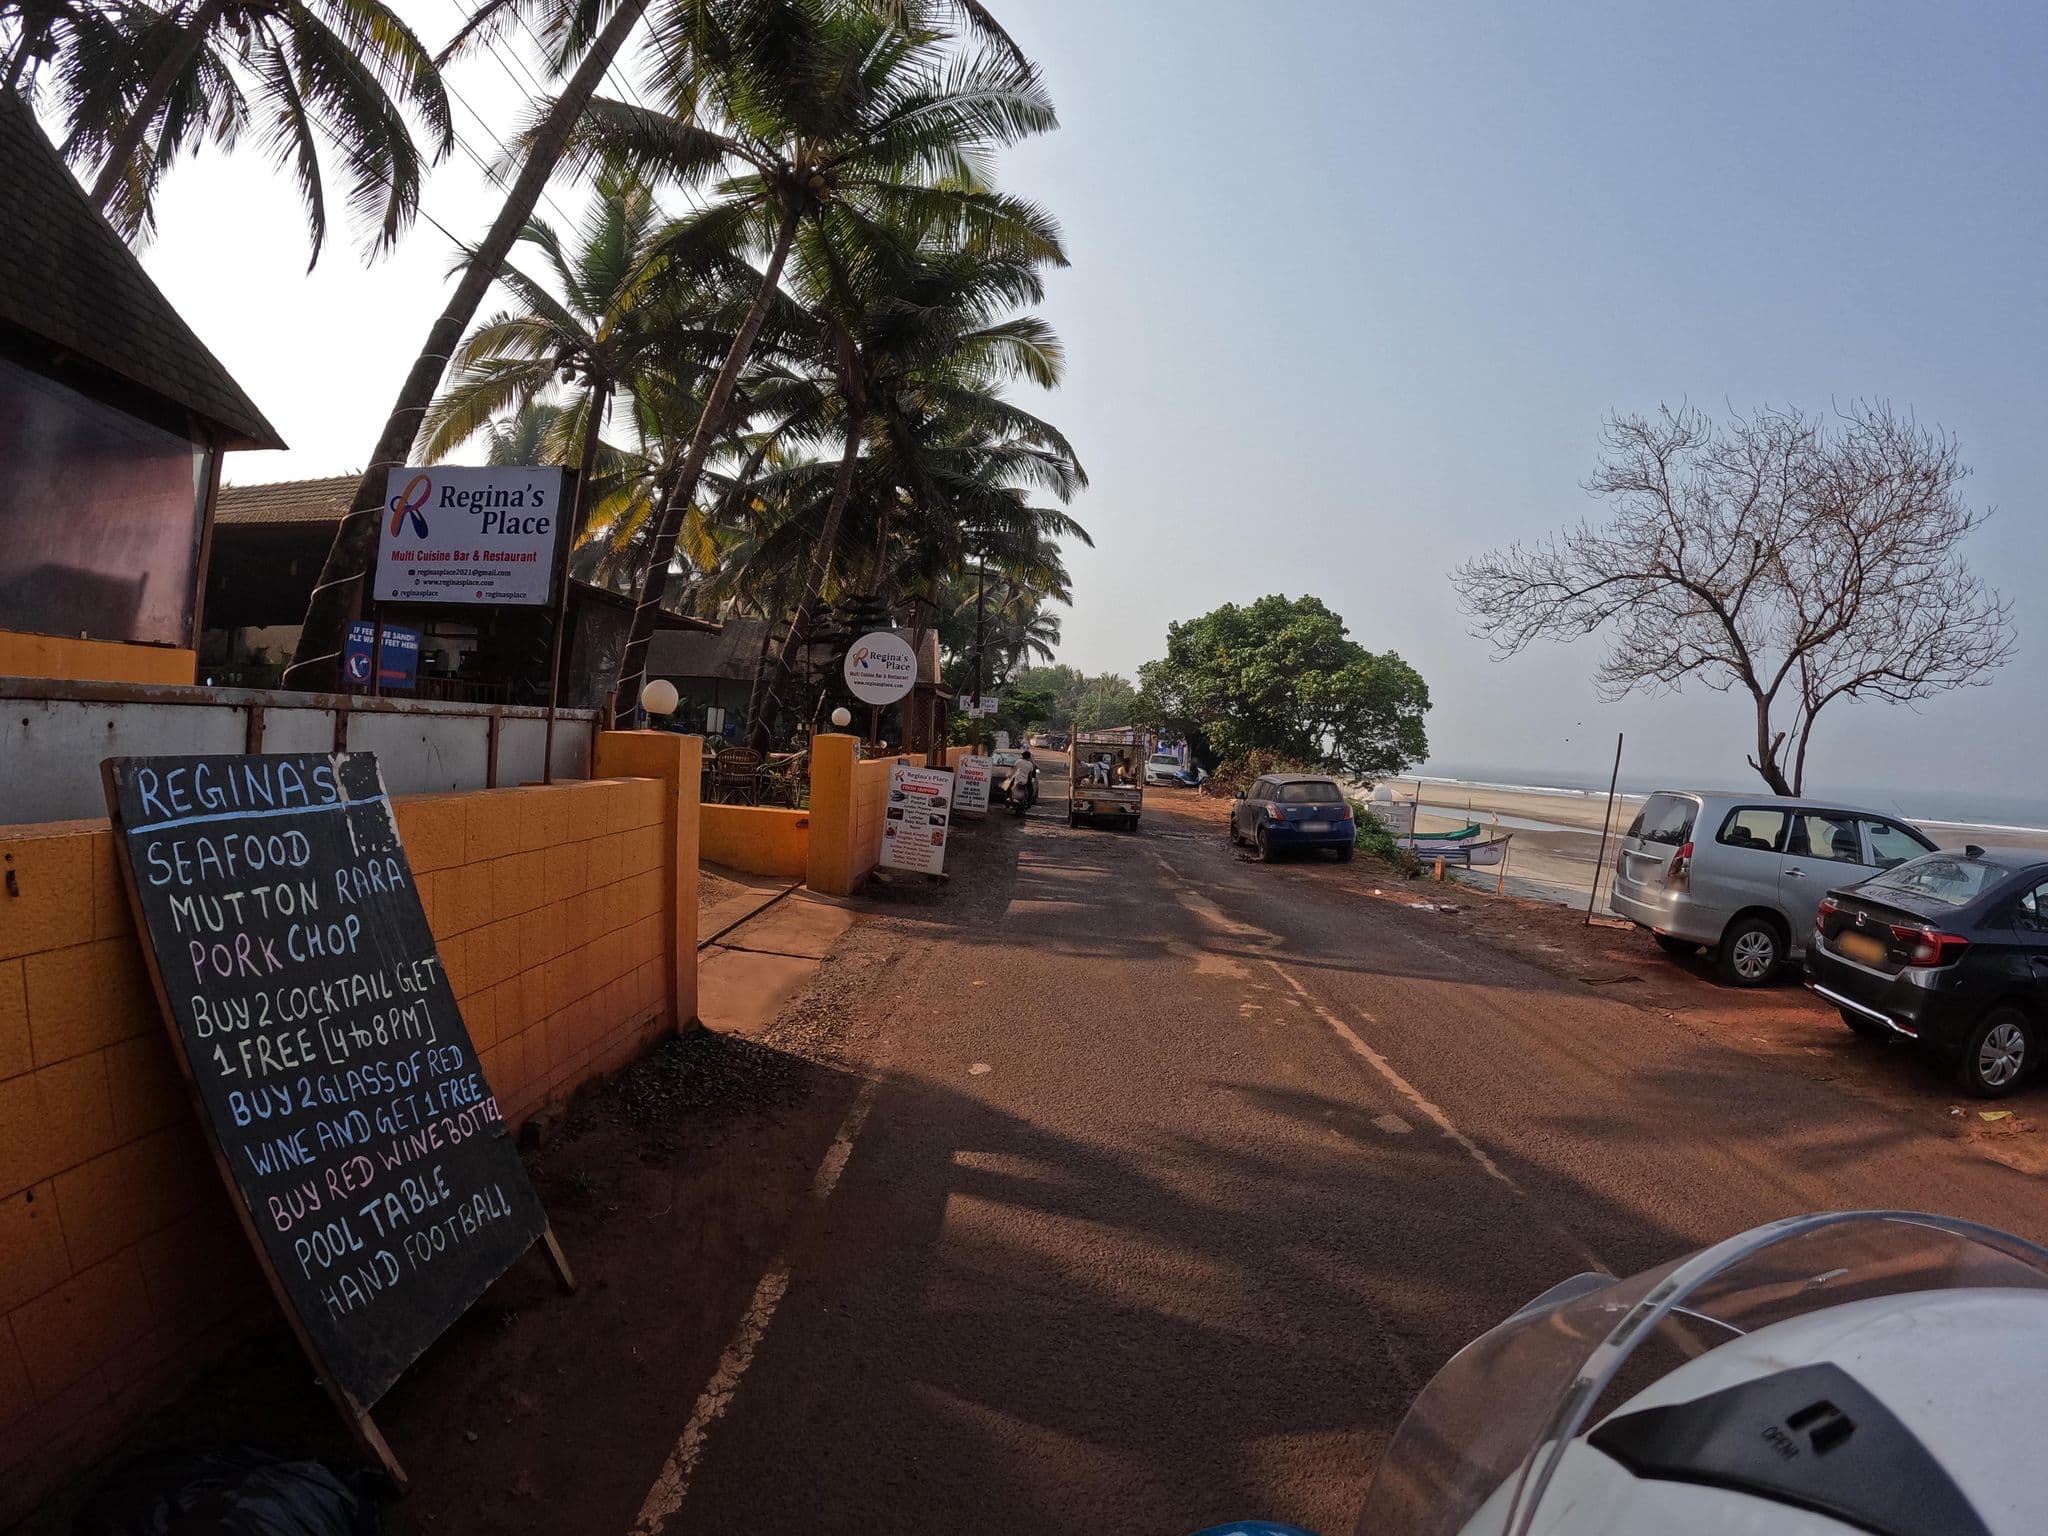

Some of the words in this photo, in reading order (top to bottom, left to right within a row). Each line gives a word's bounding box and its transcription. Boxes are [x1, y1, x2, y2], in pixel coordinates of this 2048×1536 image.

[439, 484, 545, 514] Regina's
[480, 511, 549, 535] Place
[391, 551, 414, 561] Multi
[417, 551, 450, 561] Cuisine
[453, 551, 469, 561] Bar
[472, 552, 480, 561] &
[483, 551, 537, 562] Restaurant
[423, 579, 494, 587] www.reginasplace.com
[349, 634, 361, 642] PLZ
[385, 639, 400, 647] FEET
[362, 627, 375, 635] FEE
[870, 652, 908, 662] Regina's
[886, 661, 910, 671] Place
[138, 759, 337, 817] REGINA'S
[148, 831, 310, 886] SEAFOOD
[169, 878, 319, 932] MUTTON
[336, 857, 405, 904] RARA
[189, 932, 283, 984] PORK
[288, 914, 360, 962] CHOP
[191, 995, 250, 1038] BUY
[255, 992, 273, 1027] 2
[276, 970, 392, 1022] COCKTAIL
[396, 959, 437, 993] GET
[213, 1044, 237, 1076] 1
[238, 1028, 316, 1079] FREE
[228, 1084, 292, 1127] BUY
[317, 1061, 395, 1105] GLASS
[396, 1050, 421, 1087] OF
[427, 1044, 464, 1077] RED
[244, 1128, 316, 1177] WINE
[316, 1109, 372, 1152] AND
[375, 1095, 420, 1135] GET
[424, 1091, 440, 1116] 1
[438, 1073, 482, 1109] FREE
[268, 1181, 322, 1232] BUY
[325, 1155, 375, 1201] RED
[377, 1122, 444, 1171] WINE
[441, 1095, 503, 1145] BOTTEL
[295, 1216, 364, 1280] POOL
[359, 1165, 450, 1238] TABLE
[320, 1250, 400, 1321] HAND
[403, 1183, 512, 1271] FOOTBALL
